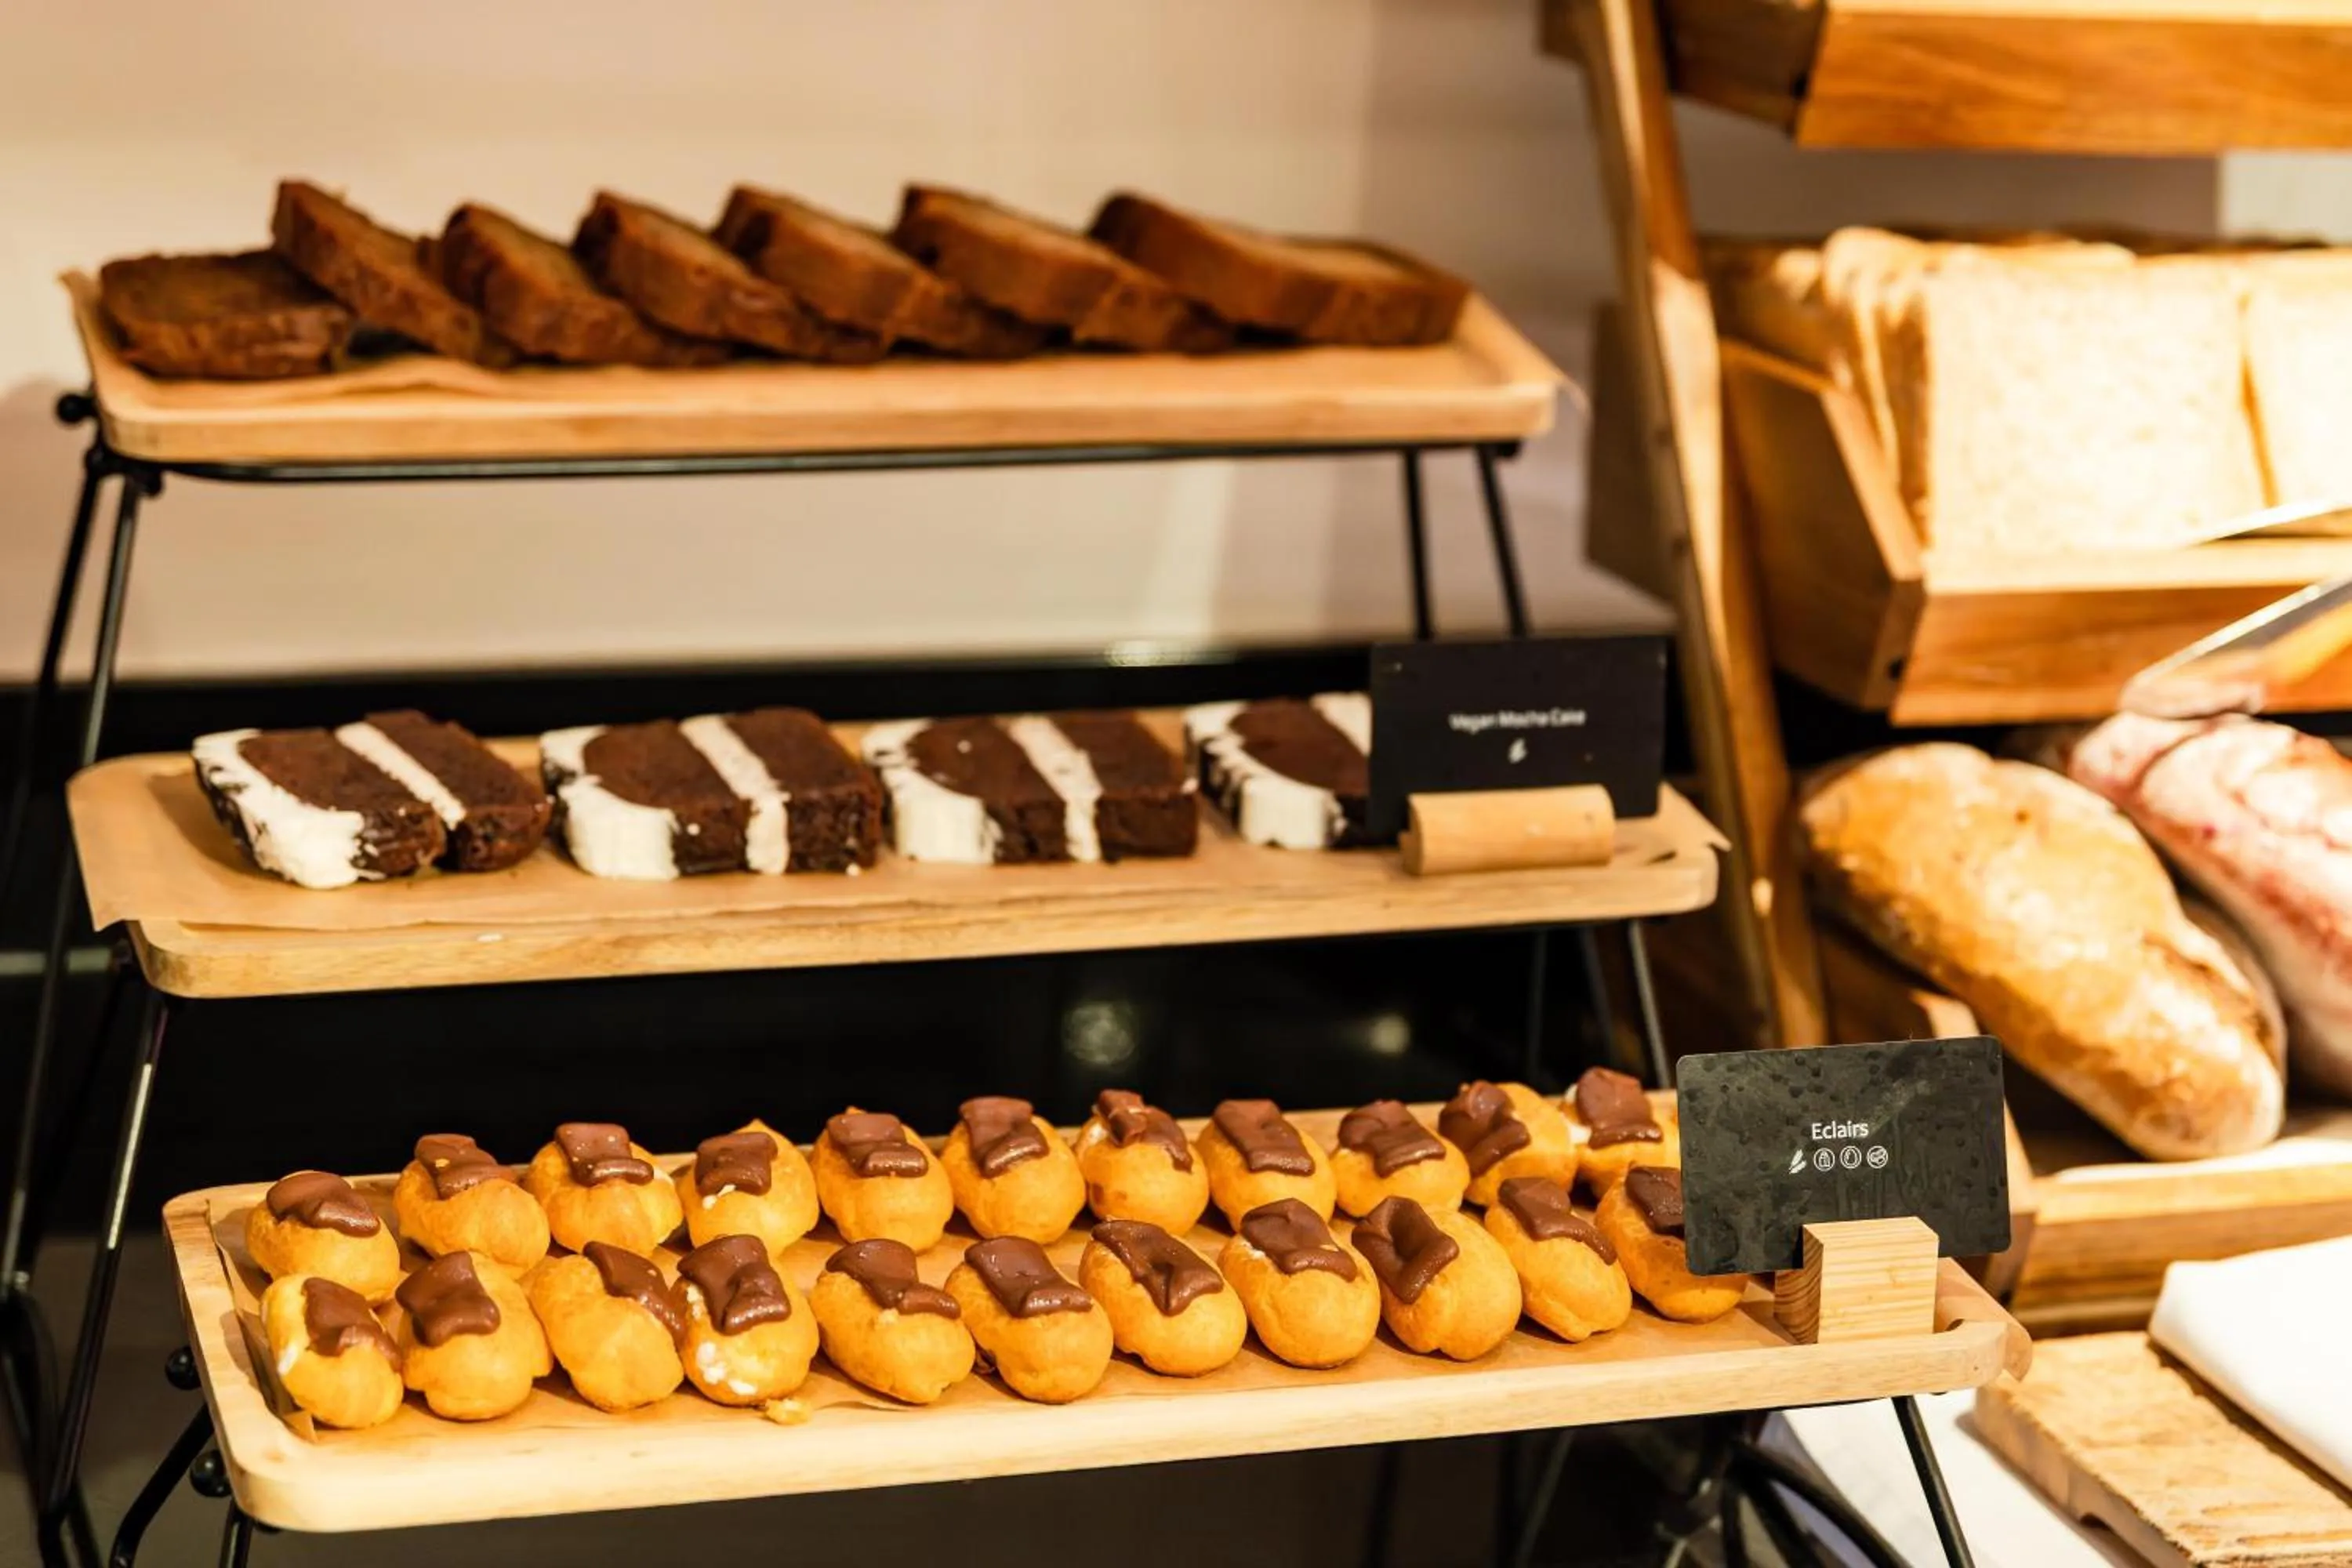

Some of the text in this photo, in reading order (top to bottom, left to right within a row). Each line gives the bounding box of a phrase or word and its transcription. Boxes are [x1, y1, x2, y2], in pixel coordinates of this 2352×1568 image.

[1449, 713, 1495, 735] Vegan
[1497, 710, 1548, 728] Mocha
[1812, 1120, 1869, 1140] Eclairs
